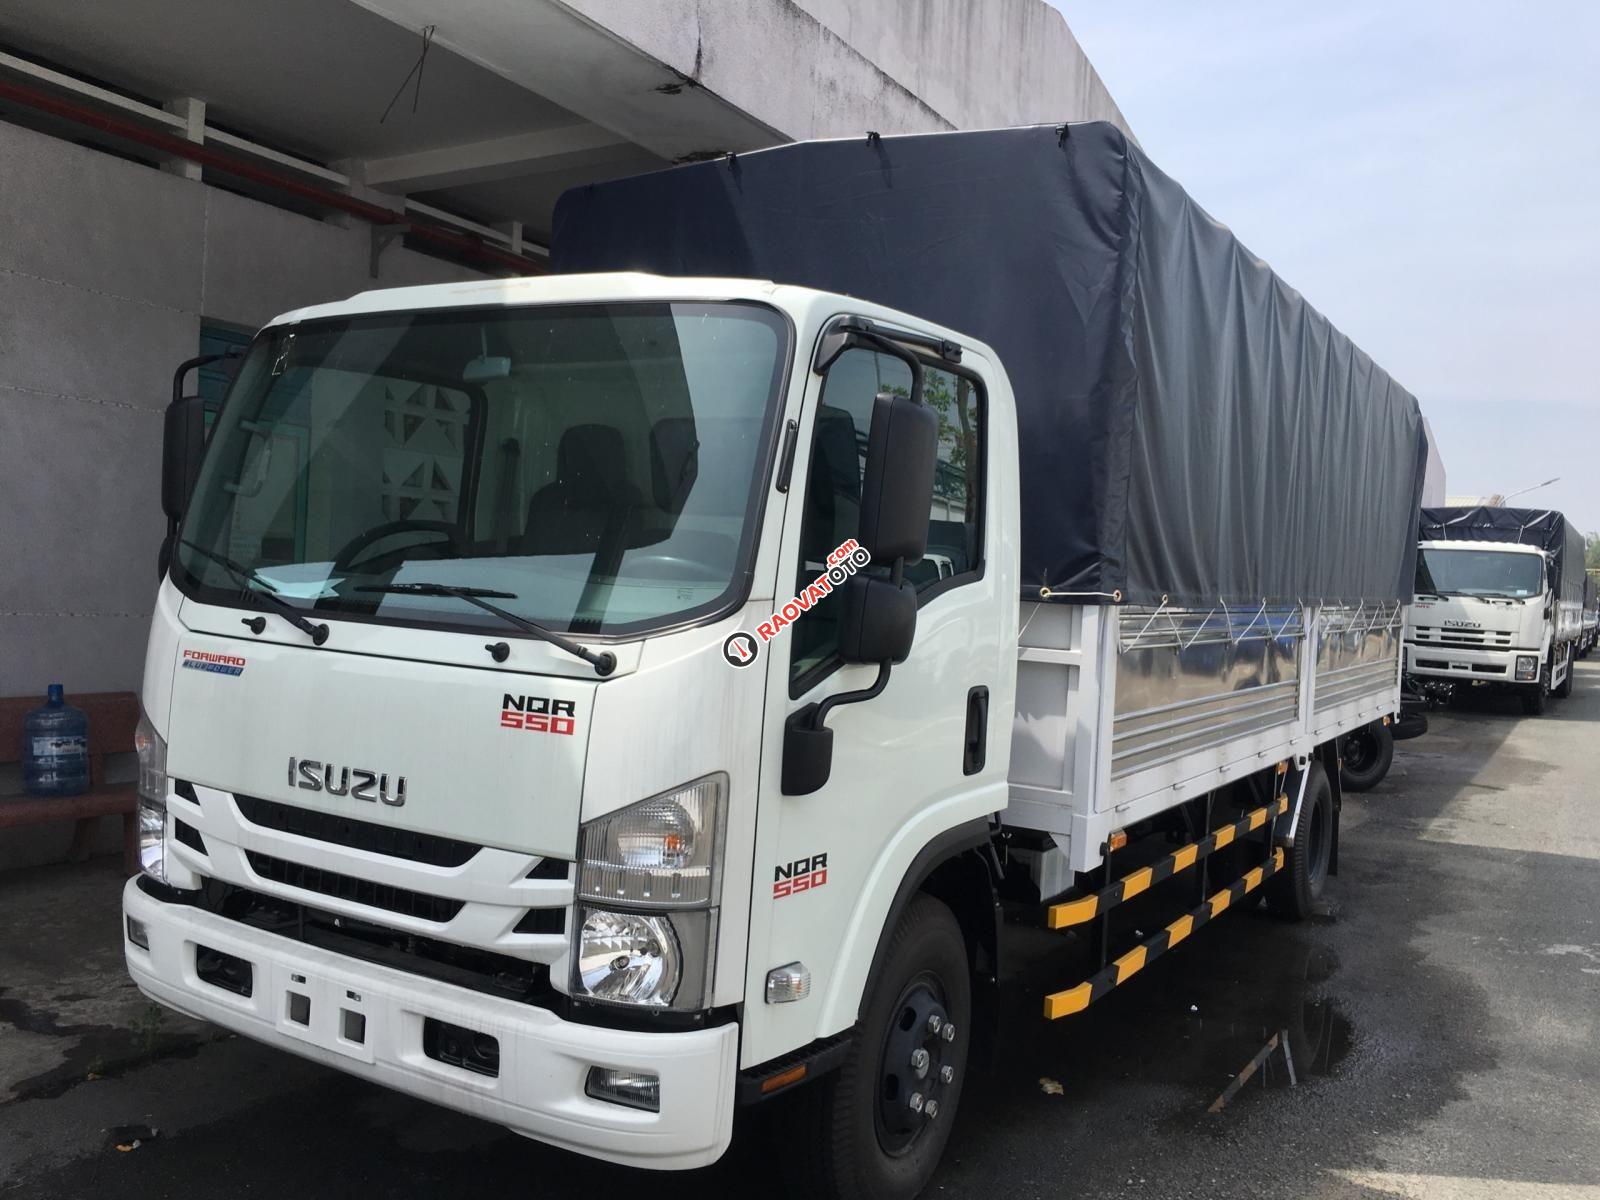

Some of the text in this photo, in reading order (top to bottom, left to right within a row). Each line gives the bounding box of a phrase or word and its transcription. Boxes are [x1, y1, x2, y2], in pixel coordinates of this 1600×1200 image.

[1444, 620, 1481, 629] ISUZU
[183, 649, 246, 667] FORWARD
[502, 693, 576, 718] NQR
[500, 710, 575, 736] 550
[288, 756, 407, 808] ISUZU
[774, 852, 828, 882] NQR
[773, 868, 828, 900] 550
